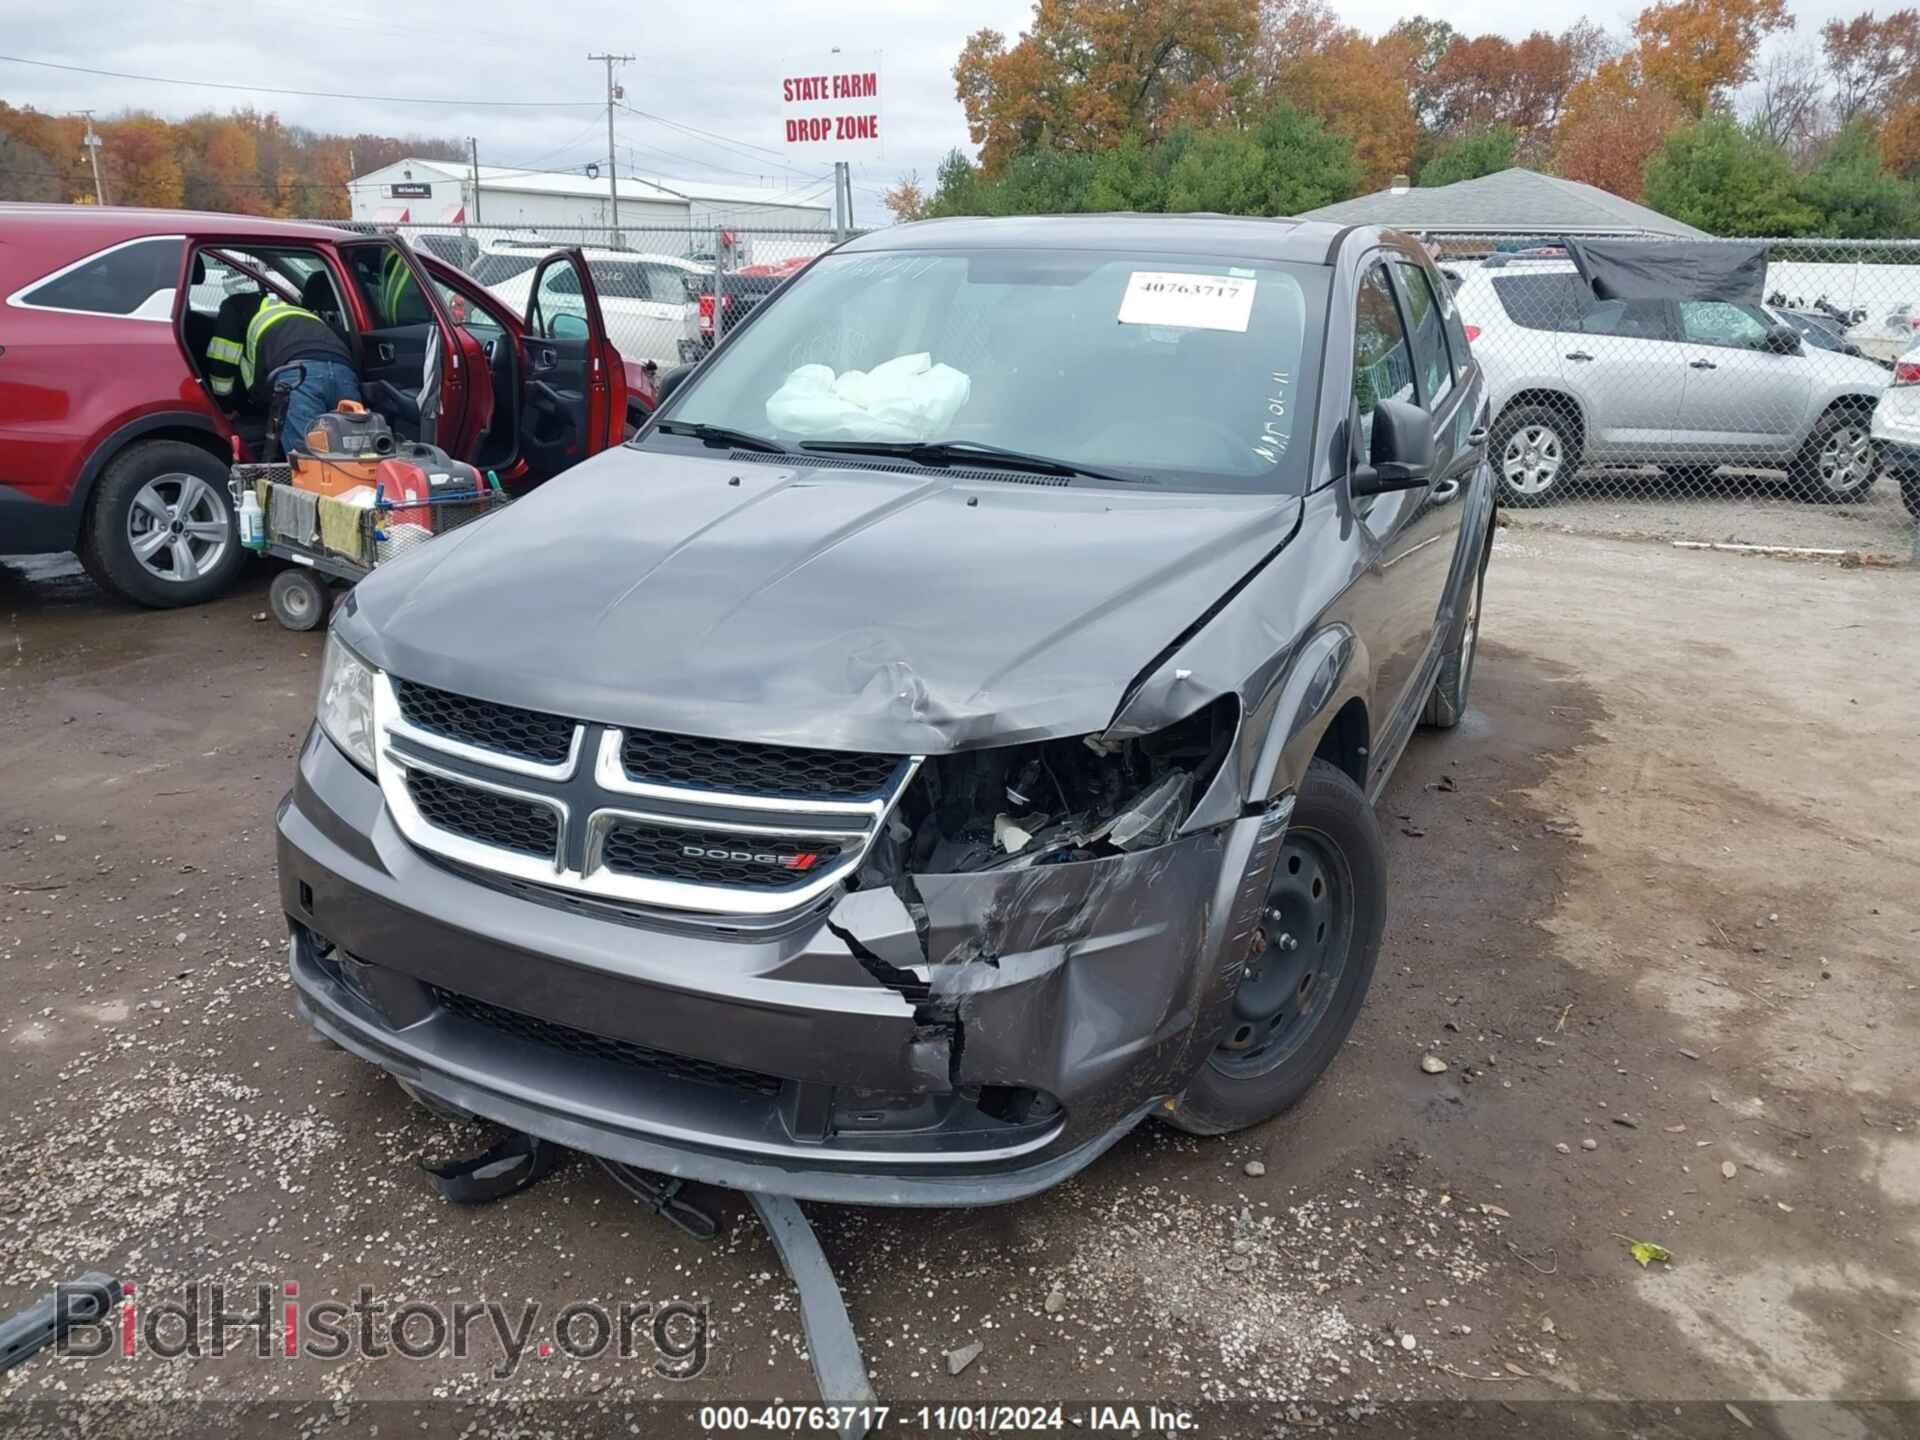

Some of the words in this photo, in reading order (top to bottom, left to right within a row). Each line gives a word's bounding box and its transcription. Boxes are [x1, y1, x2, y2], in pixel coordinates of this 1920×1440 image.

[783, 76, 829, 102] STATE
[832, 72, 877, 99] FARM
[785, 117, 832, 142] DROP
[835, 115, 878, 140] ZONE
[1140, 281, 1240, 298] 40763717
[683, 846, 800, 866] DODGE
